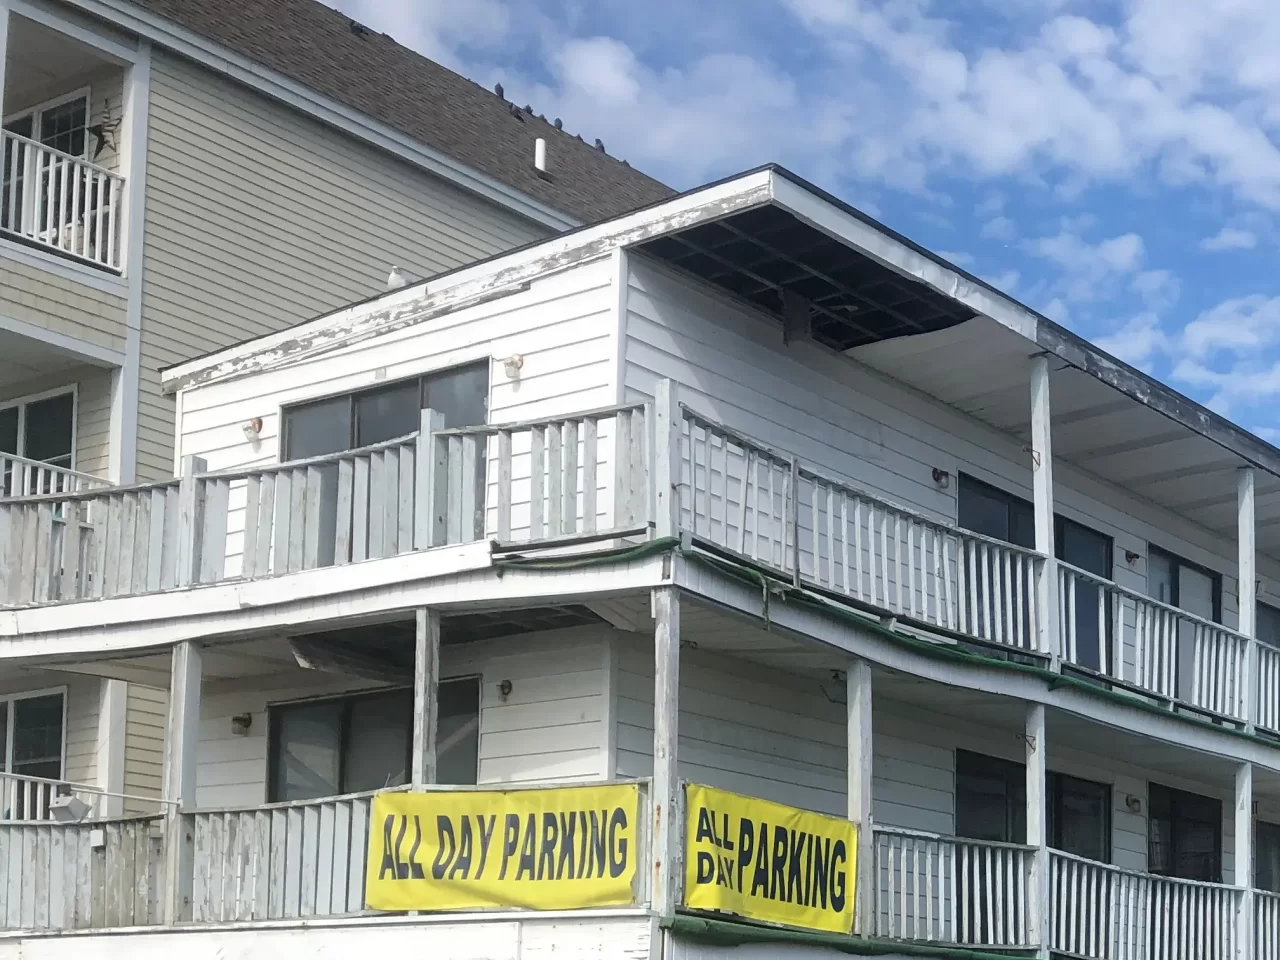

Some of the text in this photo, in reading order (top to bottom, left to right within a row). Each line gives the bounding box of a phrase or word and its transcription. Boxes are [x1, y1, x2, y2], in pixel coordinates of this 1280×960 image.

[378, 807, 628, 881] ALL DAY PARKING
[696, 807, 734, 851] ALL
[696, 851, 734, 890] DAY
[738, 817, 847, 913] PARKING
